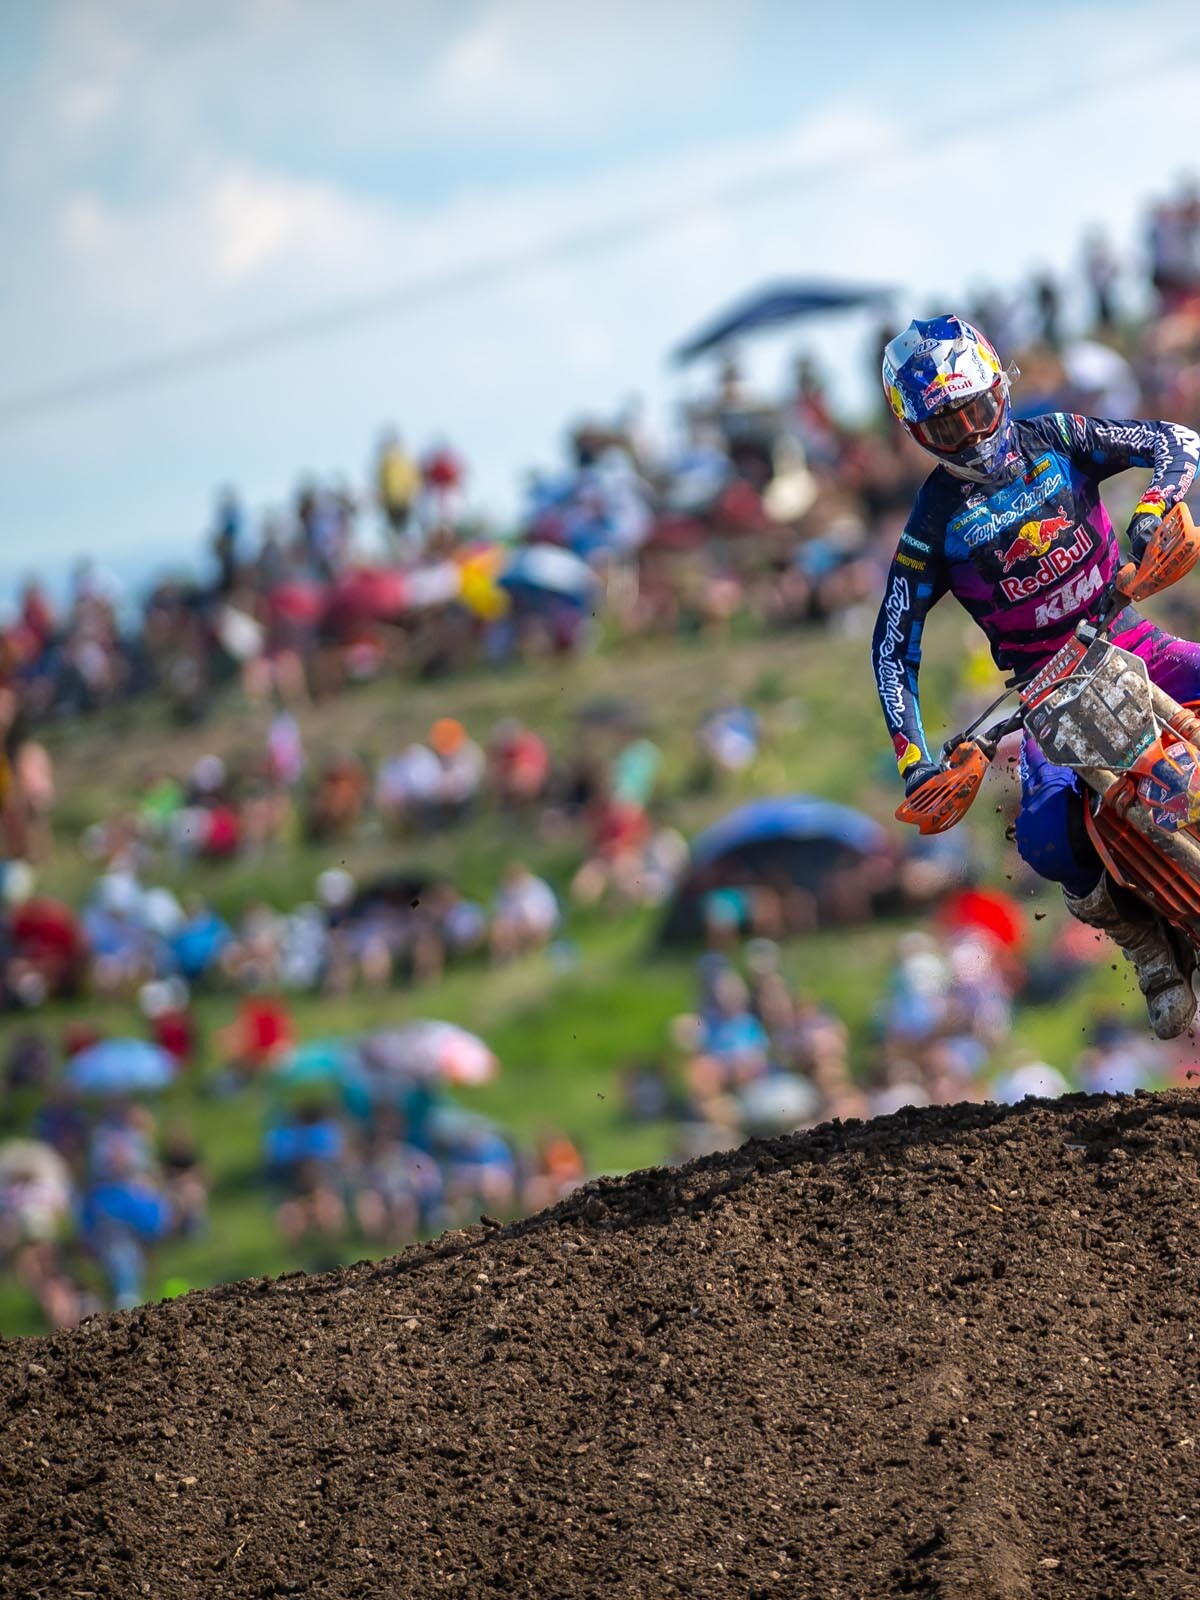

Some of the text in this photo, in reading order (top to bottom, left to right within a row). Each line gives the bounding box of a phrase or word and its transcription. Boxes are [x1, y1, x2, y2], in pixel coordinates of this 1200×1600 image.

[923, 388, 947, 410] Red
[947, 380, 973, 394] Bull
[963, 523, 994, 547] Troy
[991, 510, 1017, 533] Lee
[1011, 473, 1063, 516] Designs
[1000, 556, 1052, 602] Red
[1048, 524, 1095, 579] Bull
[1035, 563, 1104, 629] KTM
[878, 575, 911, 728] Troy Lee Designs
